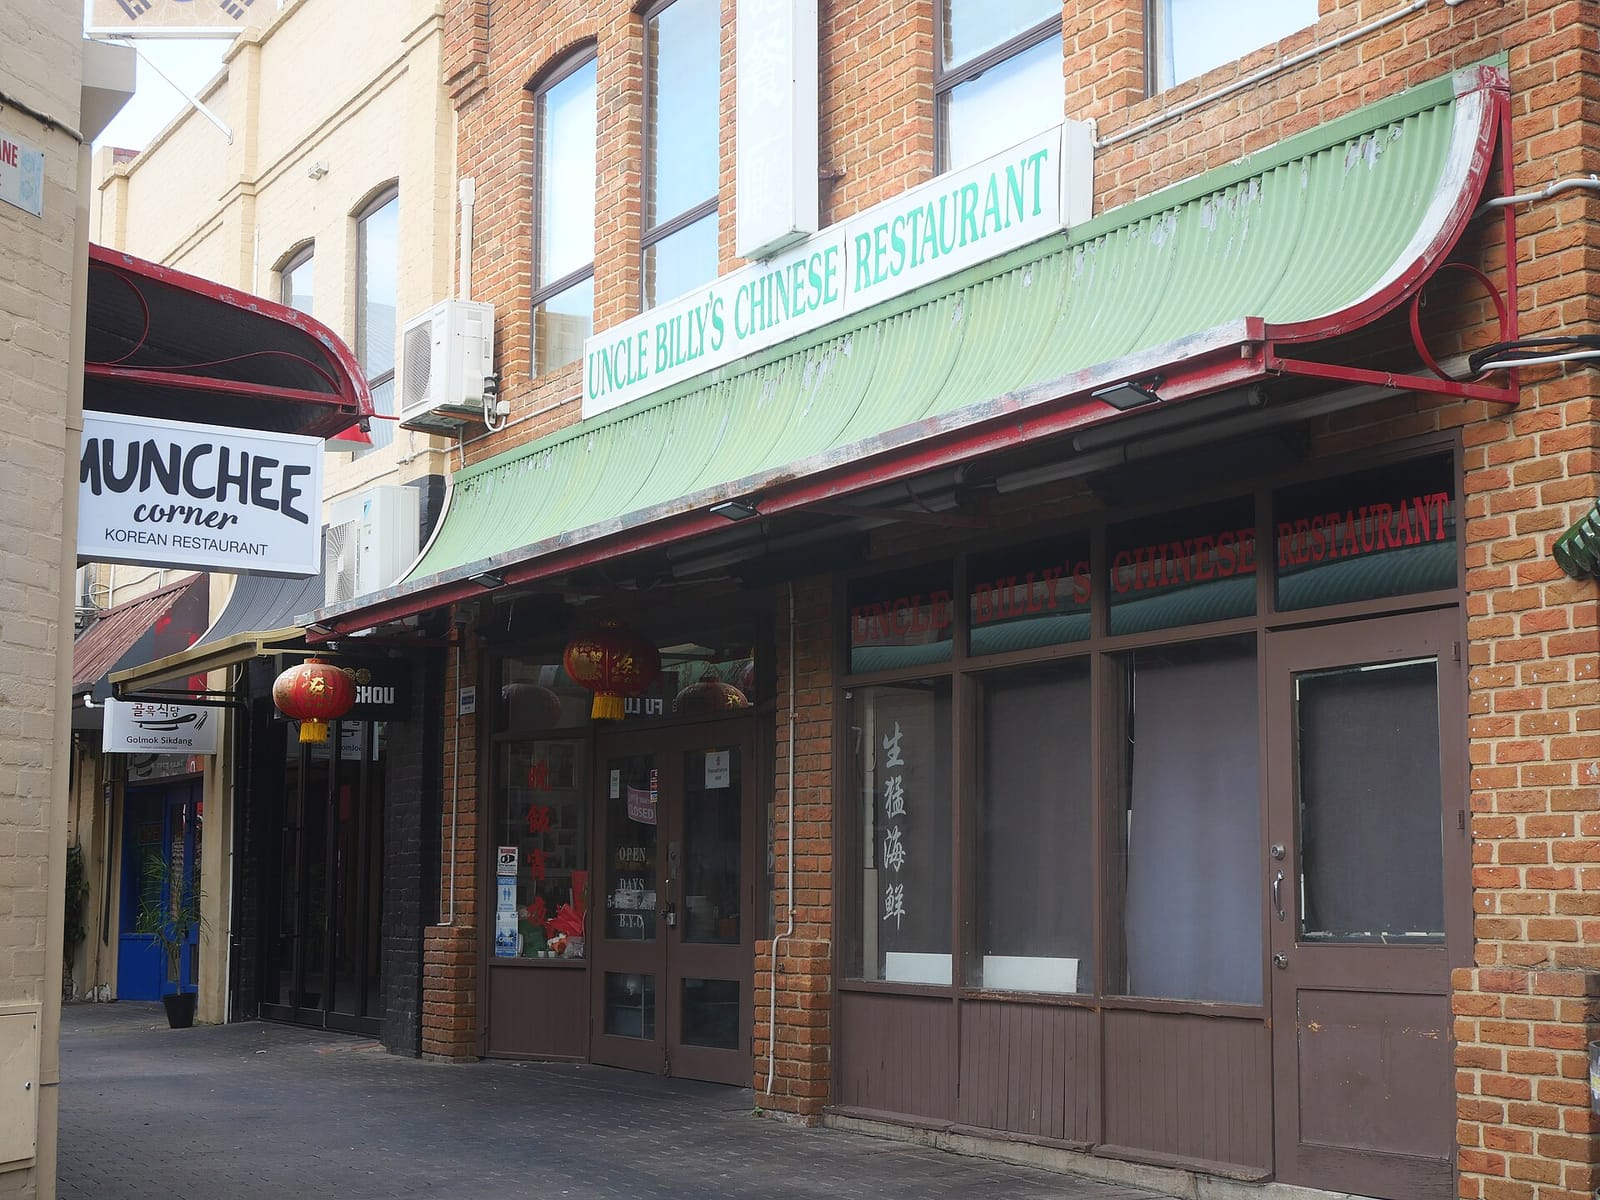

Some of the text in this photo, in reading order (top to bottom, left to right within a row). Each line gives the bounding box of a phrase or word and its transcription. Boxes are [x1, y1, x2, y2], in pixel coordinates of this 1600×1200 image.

[0, 139, 17, 168] NE
[588, 148, 1048, 400] UNCLE BILLY'S CHINESE RESTAURANT
[80, 438, 311, 525] MUNCHEE
[133, 503, 238, 530] corner
[104, 528, 268, 557] KOREAN RESTAURANT
[851, 491, 1450, 643] UNCLE BILLY'S CHINESE RESTAURANT
[131, 702, 181, 718] 골목식당
[126, 736, 193, 747] Golmok Sikdang
[882, 721, 907, 931] 生猛海鮮
[619, 847, 647, 863] OPEN
